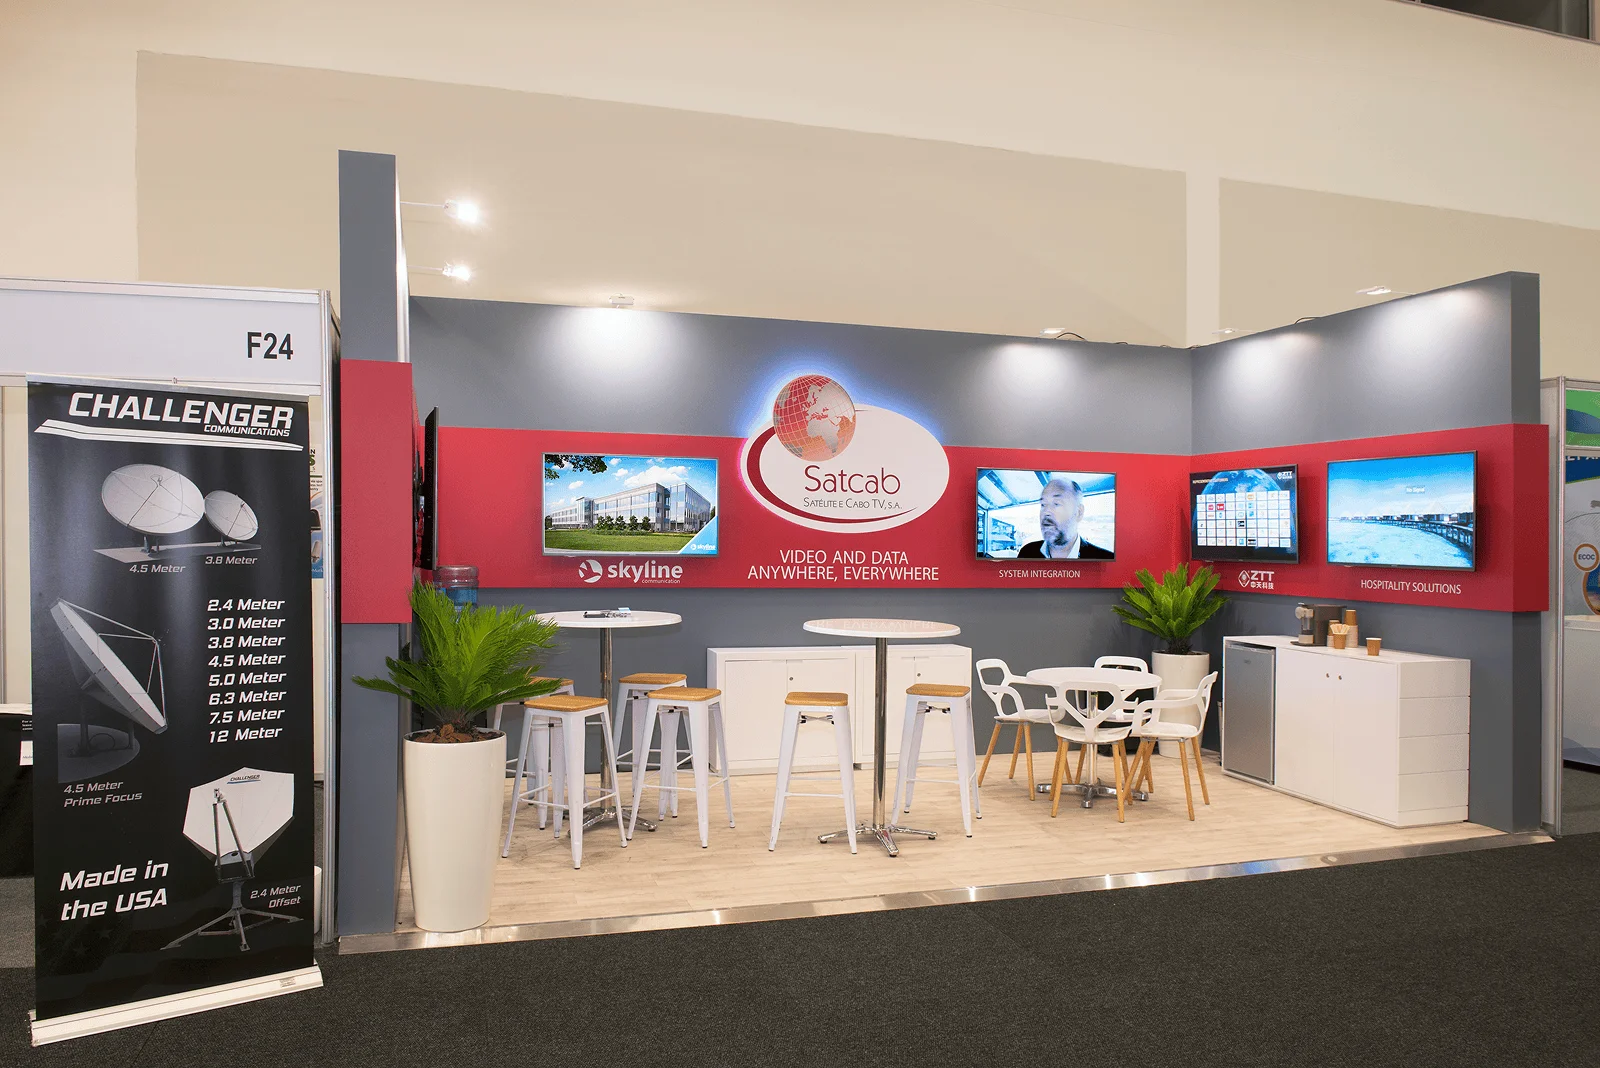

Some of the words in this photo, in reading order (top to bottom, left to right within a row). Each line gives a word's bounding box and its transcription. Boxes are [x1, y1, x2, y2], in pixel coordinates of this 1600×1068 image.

[247, 332, 294, 360] F24
[68, 392, 294, 429] CHALLENGER
[204, 424, 290, 437] COMMUNICATIONS
[804, 465, 901, 495] Satcab
[205, 556, 223, 565] 3.8
[225, 556, 258, 565] Meter
[779, 550, 827, 564] VIDEO
[832, 551, 866, 564] AND
[871, 551, 909, 565] DATA
[129, 564, 148, 573] 4.5
[151, 564, 186, 573] Meter
[607, 560, 684, 584] skyline
[747, 566, 838, 582] ANYWHERE,
[844, 567, 940, 581] EVERYWHERE
[998, 569, 1029, 578] SYSTEM
[1030, 569, 1081, 579] INTEGRATION
[1250, 570, 1275, 581] ZTT
[1250, 582, 1274, 590] 中天科技
[1360, 579, 1411, 591] HOSPITALITY
[1412, 582, 1462, 595] SOLUTIONS
[207, 599, 233, 611] 2.4
[237, 598, 285, 611] Meter
[207, 617, 234, 630] 3.0
[237, 617, 286, 629] Meter
[207, 636, 234, 649] 3.8
[238, 635, 286, 648] Meter
[208, 654, 235, 668] 4.5
[238, 653, 286, 667] Meter
[208, 673, 236, 687] 5.0
[239, 672, 287, 685] Meter
[208, 692, 236, 706] 6.3
[239, 690, 287, 704] Meter
[209, 711, 234, 725] 7.5
[237, 708, 285, 722] Meter
[209, 730, 229, 743] 12
[235, 727, 283, 741] Meter
[63, 783, 84, 794] 4.5
[87, 781, 124, 792] Meter
[63, 797, 102, 808] Prime
[105, 792, 143, 804] Focus
[60, 864, 138, 892] Made
[144, 860, 169, 880] in
[250, 888, 268, 900] 2.4
[269, 884, 301, 896] Meter
[60, 899, 108, 921] the
[115, 888, 168, 913] USA
[268, 896, 301, 909] Offset
